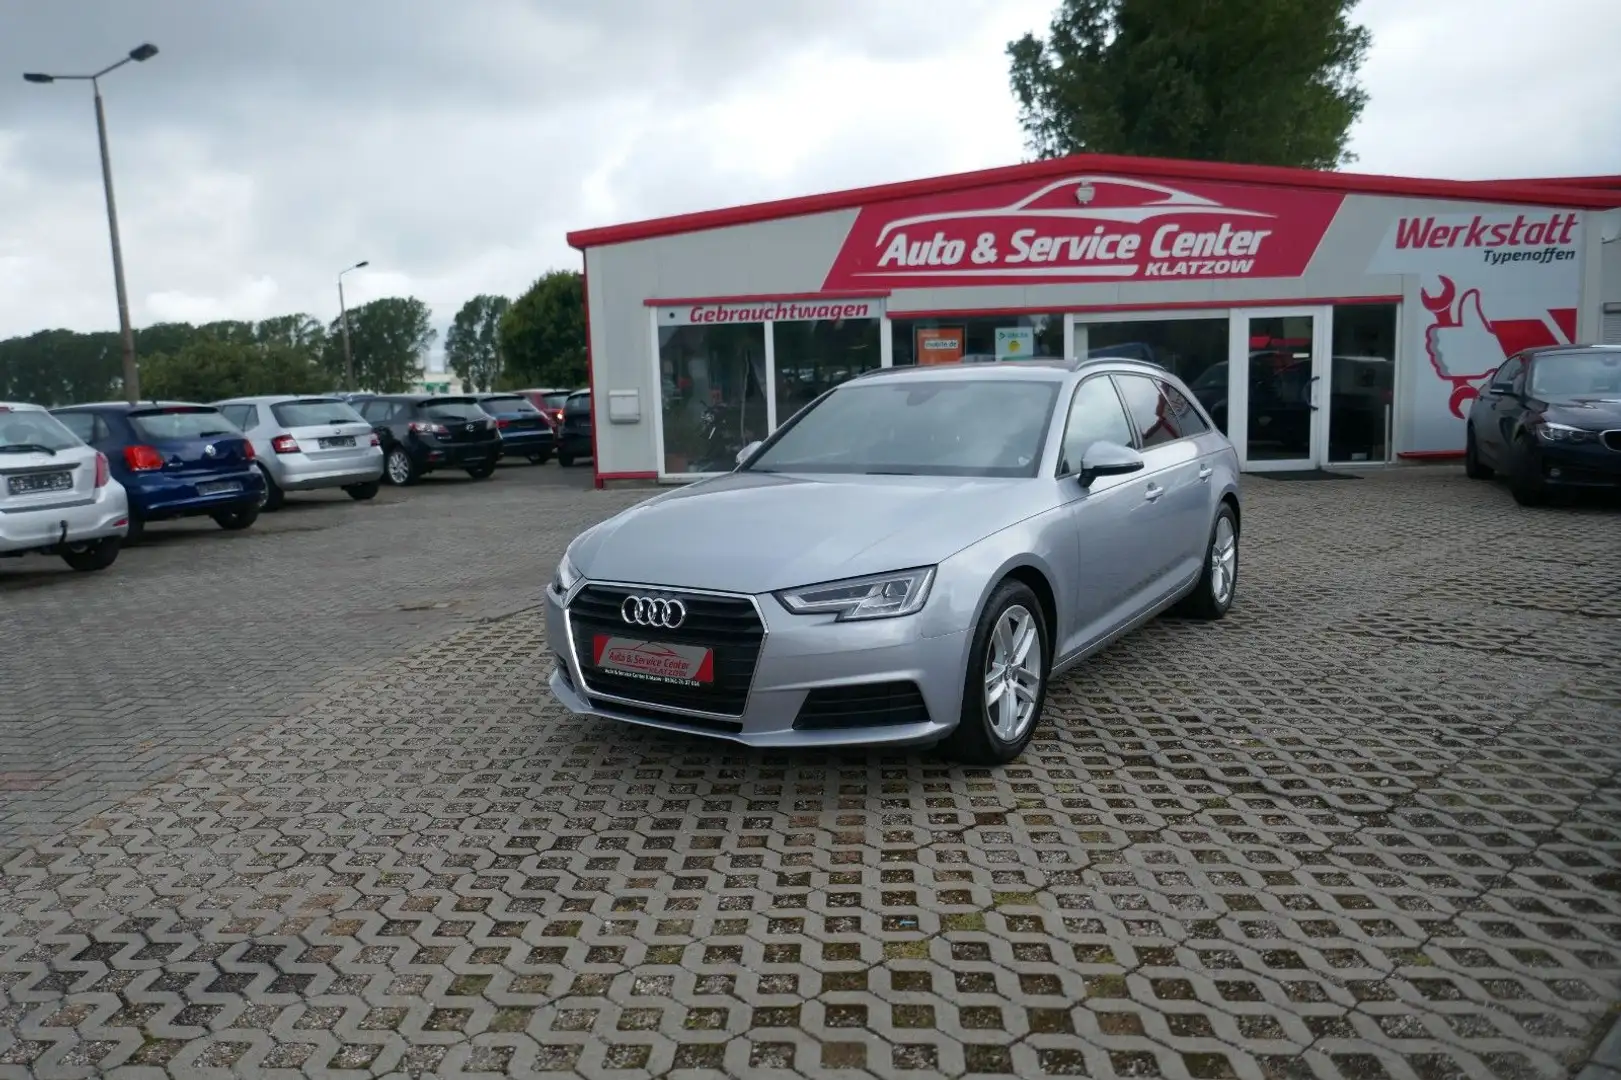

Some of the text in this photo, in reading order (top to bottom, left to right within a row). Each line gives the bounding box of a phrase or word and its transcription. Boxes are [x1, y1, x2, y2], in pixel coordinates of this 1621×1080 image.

[1395, 212, 1579, 249] Werkstatt
[877, 222, 1272, 266] Auto & Service Center
[1483, 248, 1576, 265] Typenoffen
[1145, 259, 1254, 276] KLATZOW
[690, 303, 868, 323] Gebrauchtwagen
[609, 652, 625, 661] Auto
[634, 655, 661, 666] Service
[664, 658, 690, 669] Center
